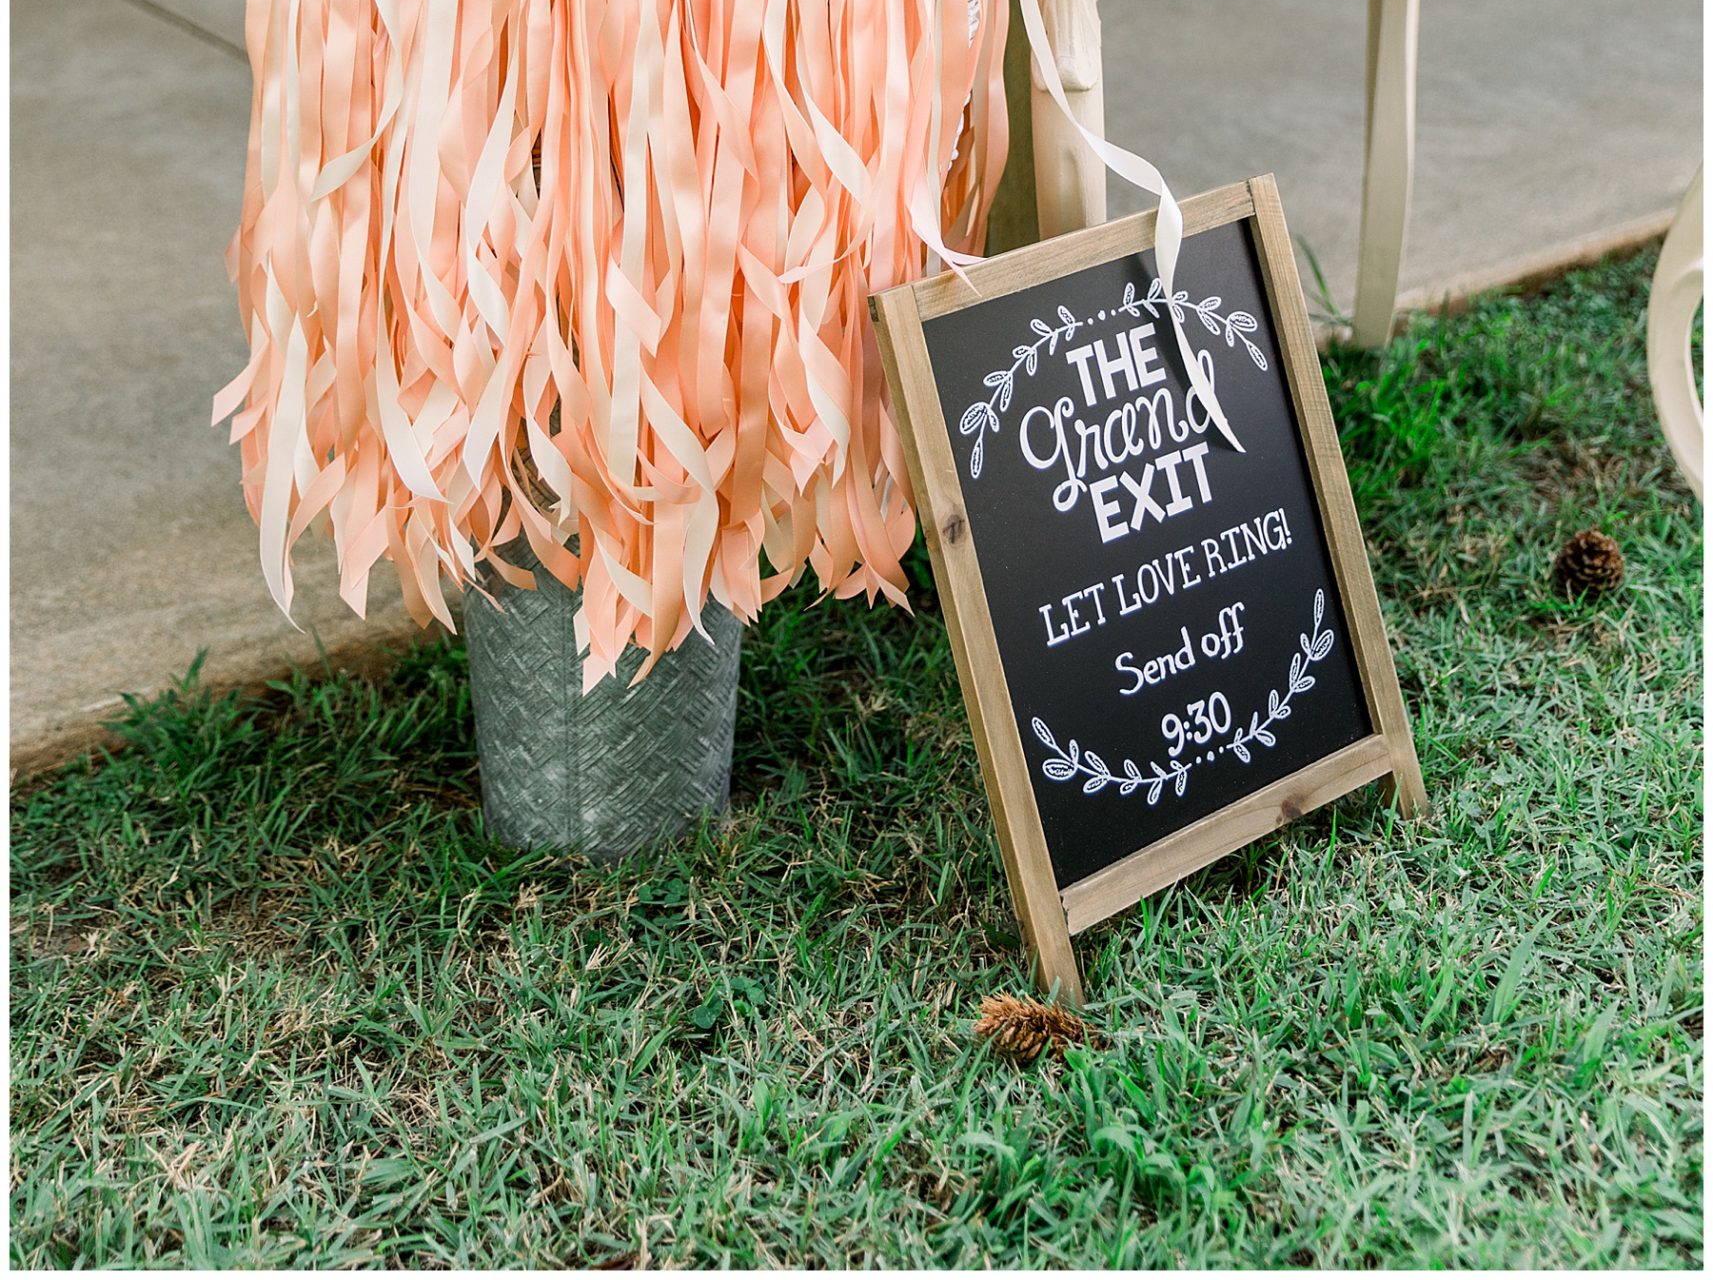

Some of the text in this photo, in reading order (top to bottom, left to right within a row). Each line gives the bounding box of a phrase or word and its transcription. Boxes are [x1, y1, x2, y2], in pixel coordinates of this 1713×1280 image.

[1066, 322, 1167, 407] THE
[1089, 442, 1213, 543] EXIT
[1039, 508, 1293, 647] LET LOVE RING!
[1115, 602, 1247, 695] Send off
[1161, 691, 1232, 756] 9:30
